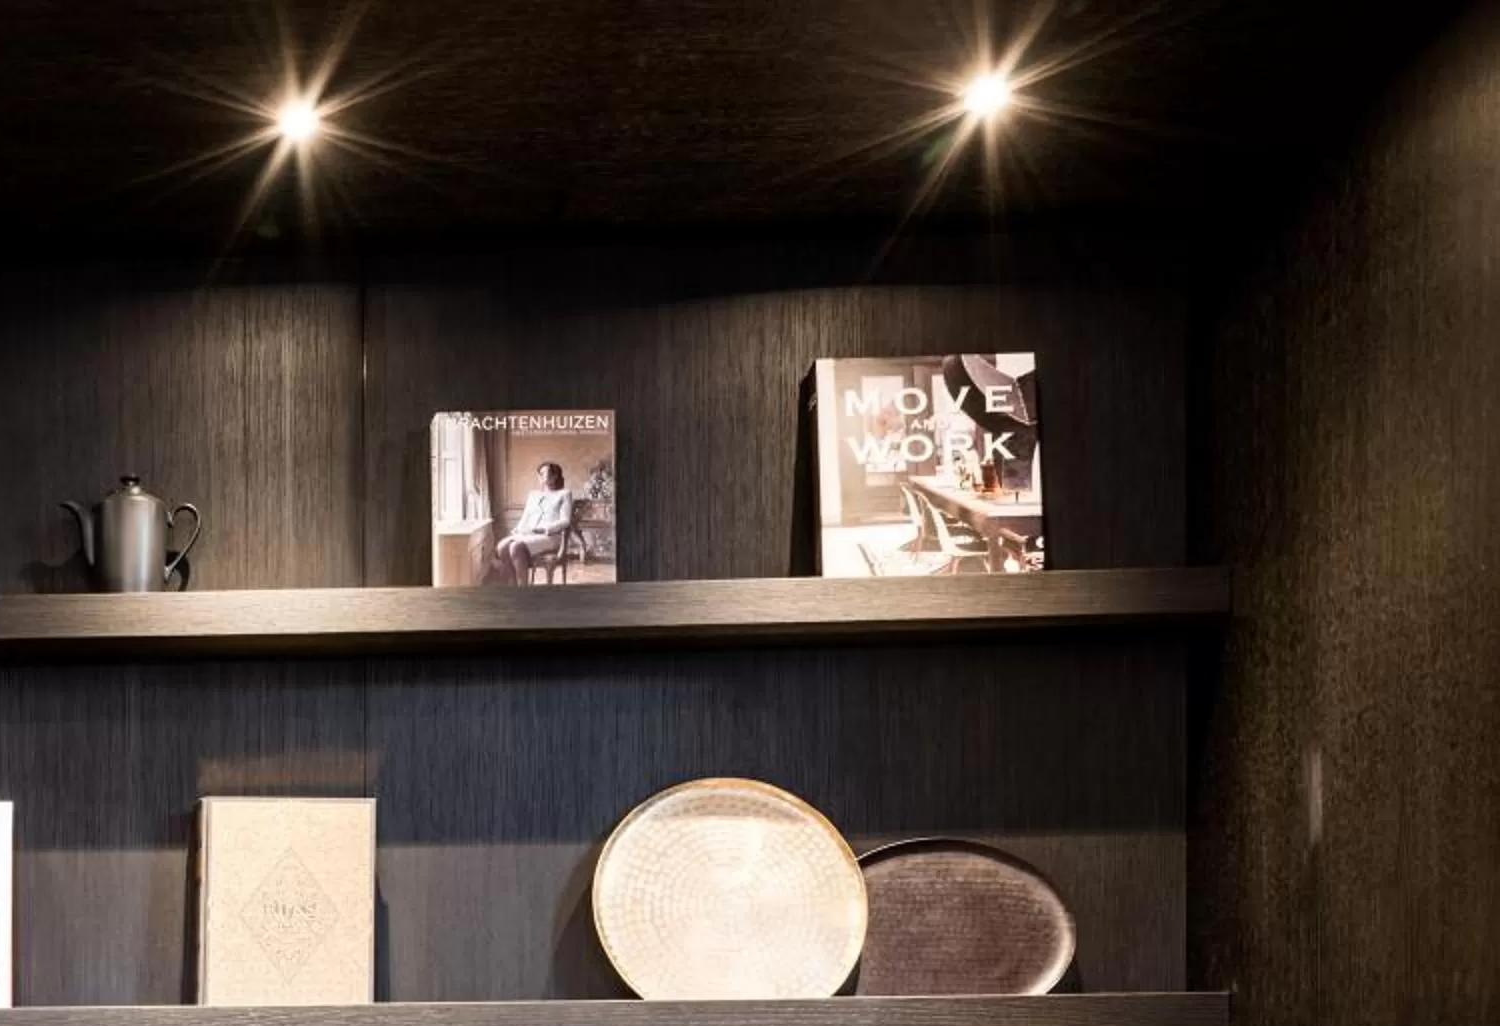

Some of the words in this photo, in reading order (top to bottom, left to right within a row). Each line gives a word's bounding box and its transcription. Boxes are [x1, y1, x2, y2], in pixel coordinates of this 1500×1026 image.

[844, 385, 1014, 417] MOVE
[446, 415, 609, 430] RACHTENHUIZEN
[844, 432, 1016, 465] WORK
